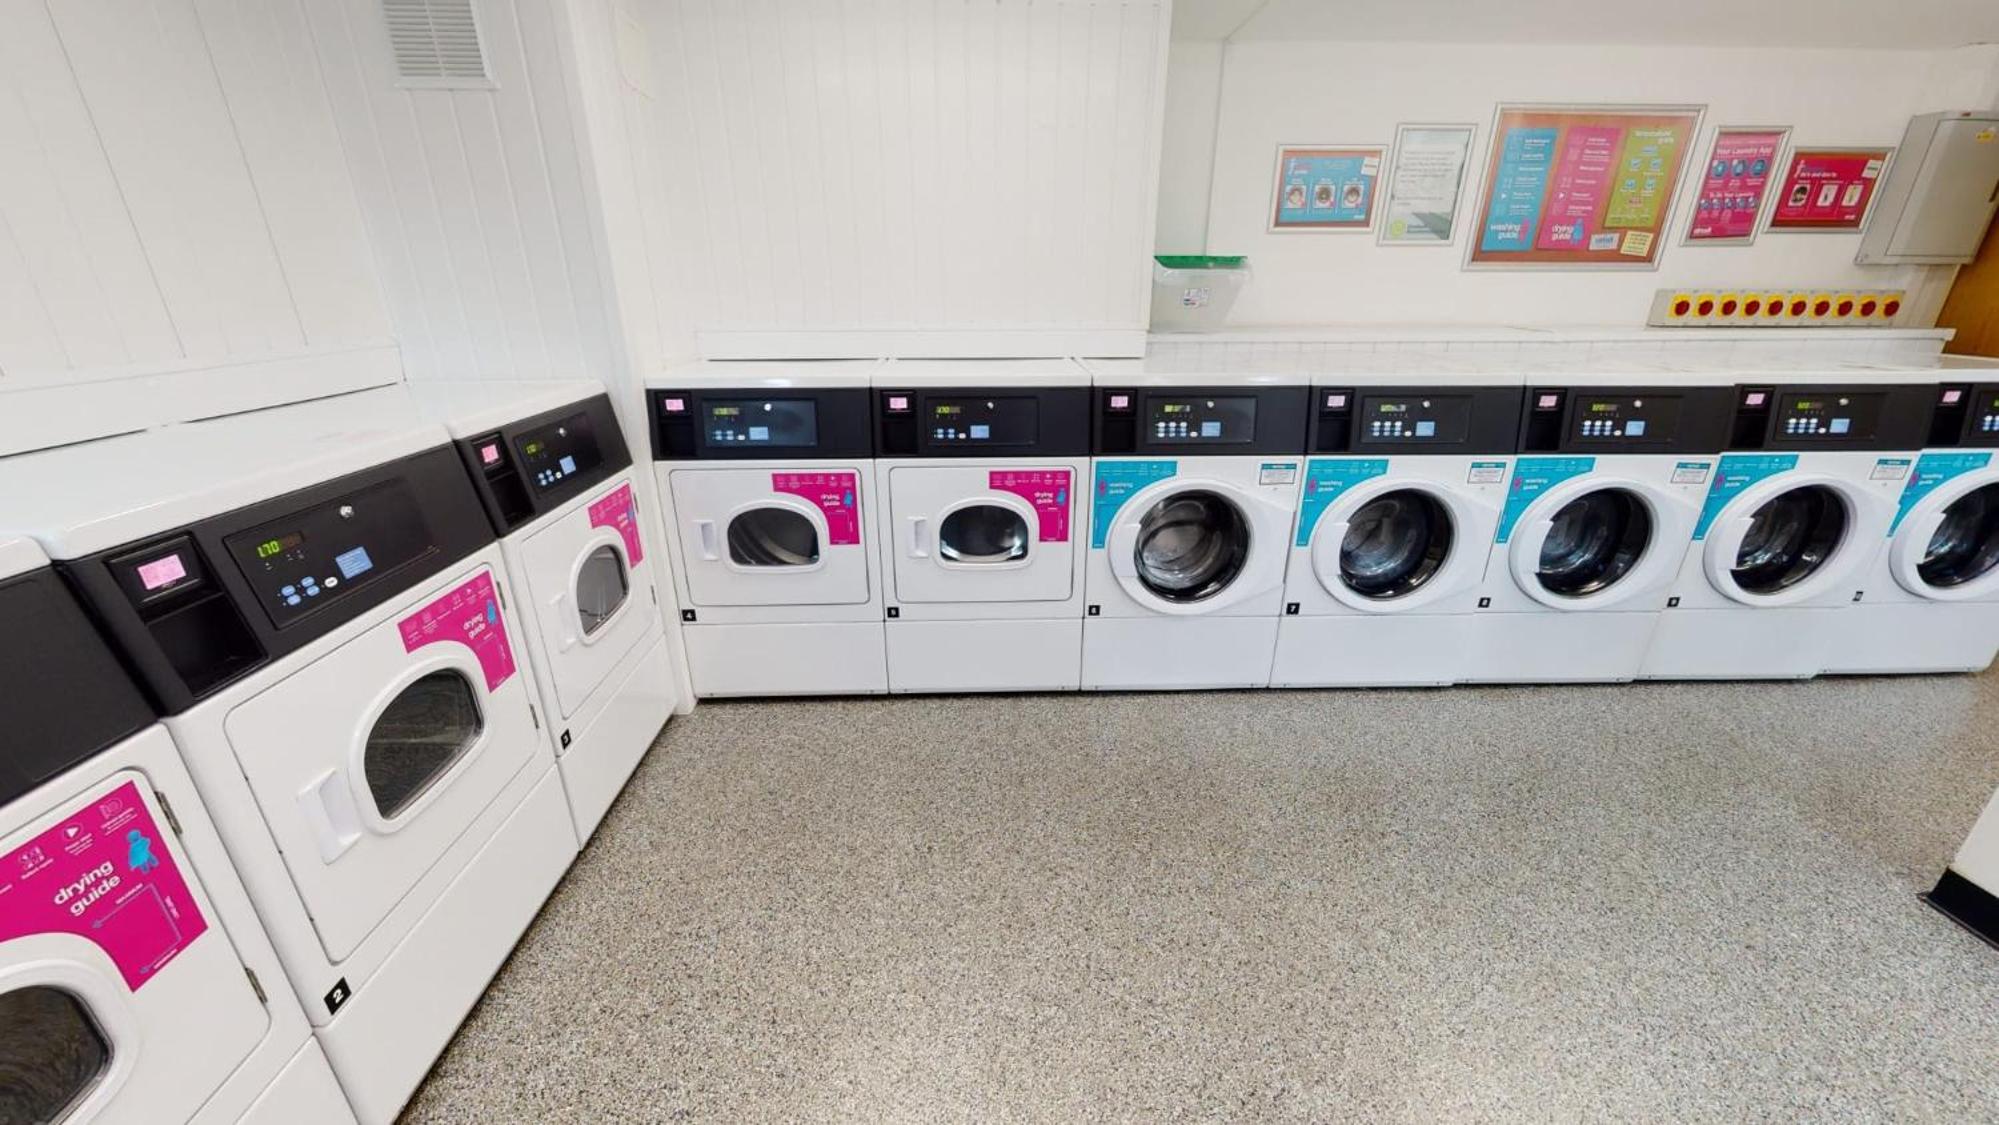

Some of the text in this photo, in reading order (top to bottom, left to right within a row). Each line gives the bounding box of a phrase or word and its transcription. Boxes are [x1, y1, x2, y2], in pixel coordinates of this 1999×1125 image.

[1490, 223, 1520, 234] washing
[1498, 232, 1519, 240] guide
[1552, 223, 1574, 234] drying
[1552, 233, 1572, 241] guide
[463, 612, 483, 630] drying
[469, 623, 486, 640] guide
[54, 860, 114, 905] drying
[70, 874, 121, 917] guide
[332, 988, 344, 1004] 2
